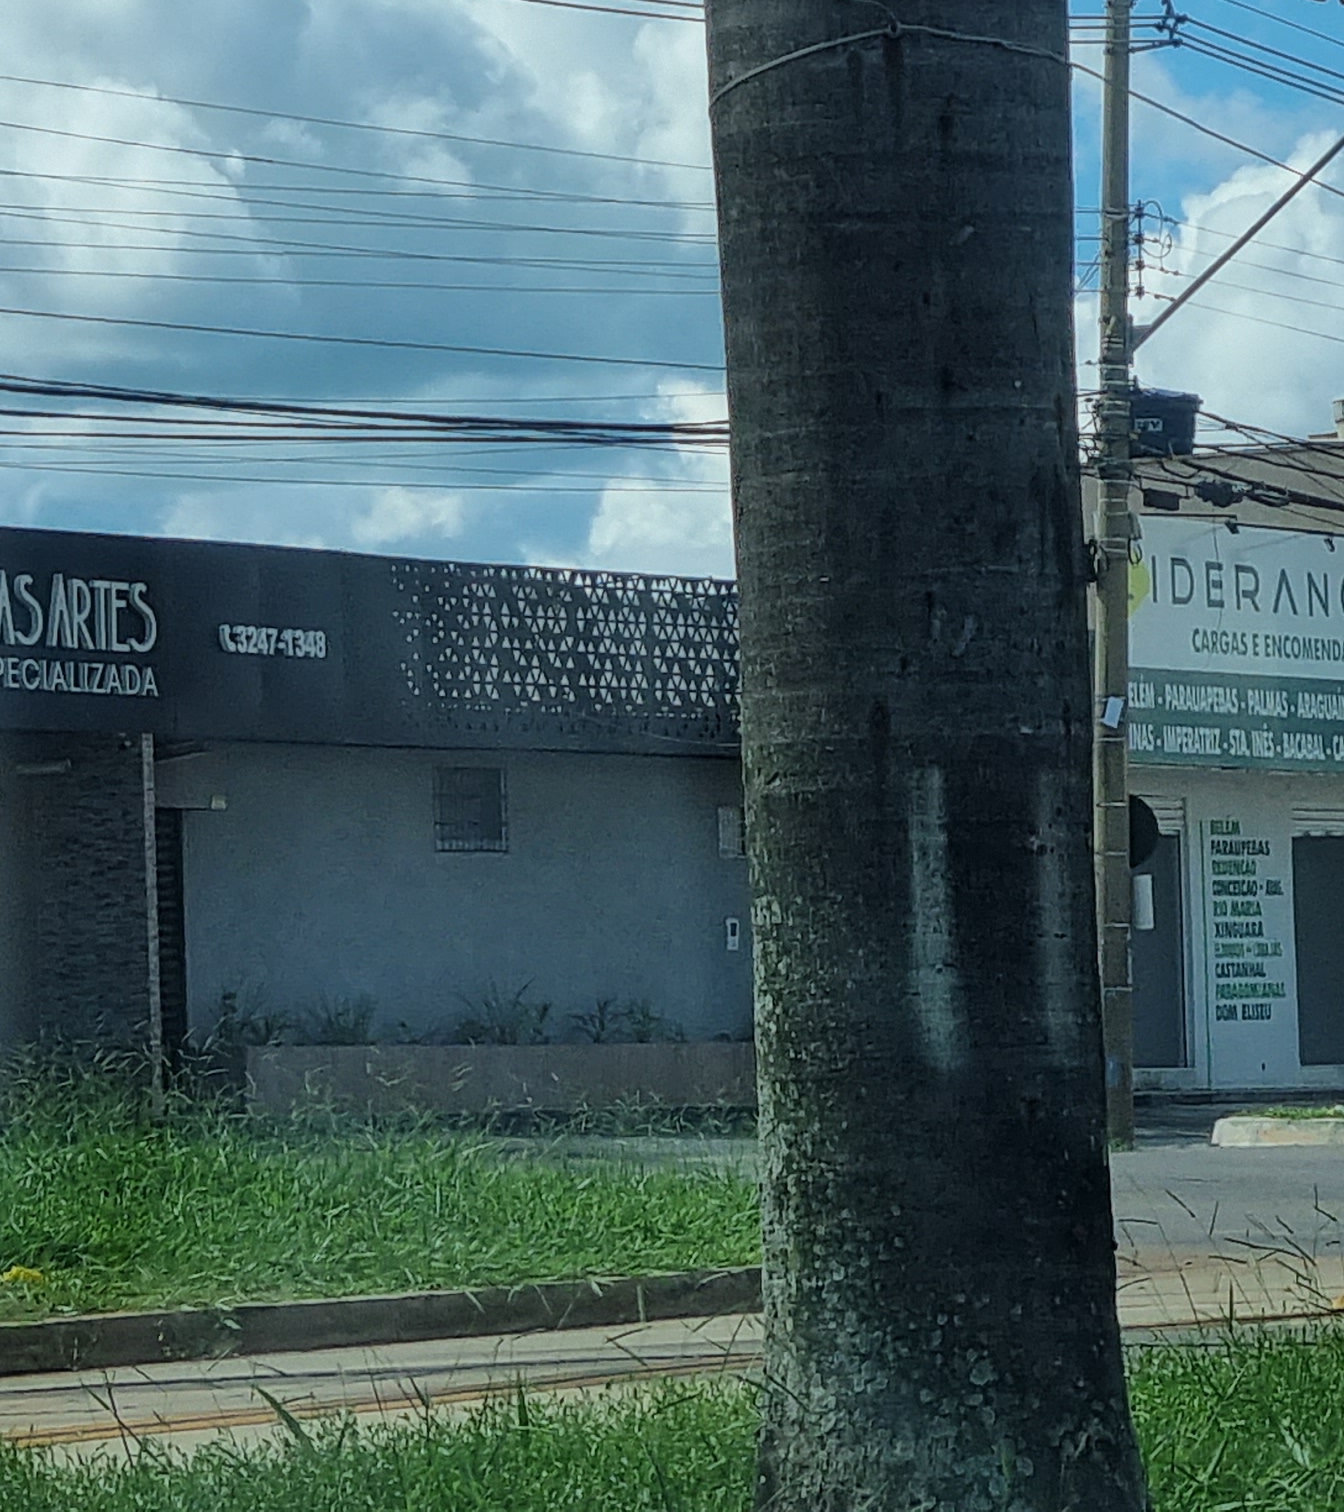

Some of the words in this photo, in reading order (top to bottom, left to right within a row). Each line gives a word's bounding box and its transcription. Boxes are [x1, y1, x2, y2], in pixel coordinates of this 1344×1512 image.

[46, 572, 157, 654] ARTES
[234, 626, 327, 659] 3247-1348
[1192, 628, 1248, 656] CARGAS
[1252, 633, 1260, 657] E
[1127, 673, 1155, 709] ELÉM
[1164, 683, 1239, 715] PARAUAPEBAS
[1247, 689, 1288, 719] PALMAS
[1162, 724, 1221, 755] IMPERATRIZ
[1229, 728, 1250, 756] STA.
[1283, 732, 1325, 761] BACABAL
